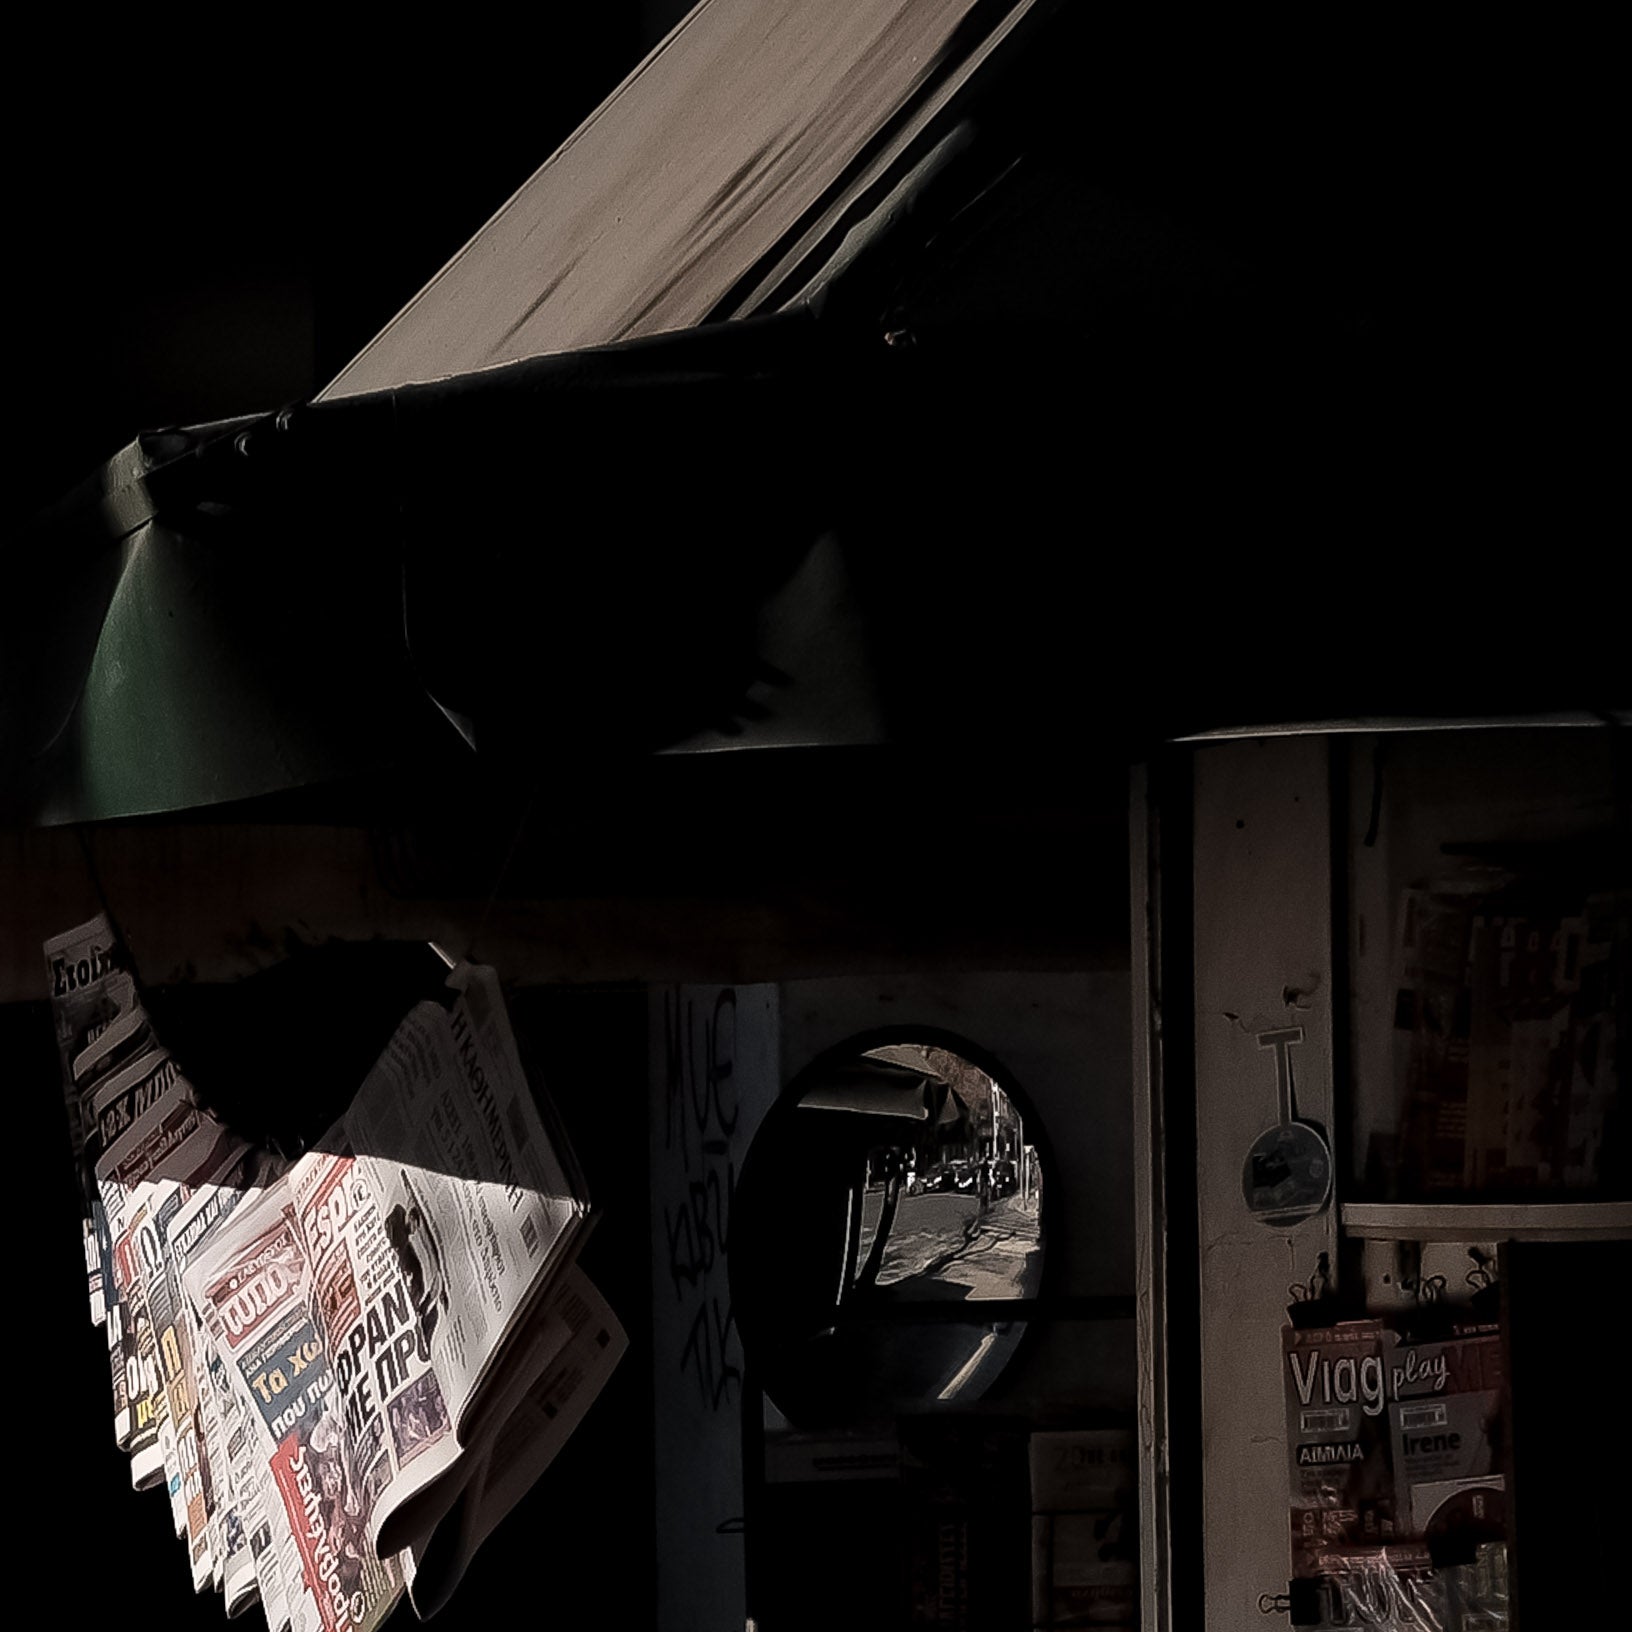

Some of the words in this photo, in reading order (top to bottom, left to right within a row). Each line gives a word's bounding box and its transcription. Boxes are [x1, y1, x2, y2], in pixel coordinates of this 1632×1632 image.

[456, 1035, 524, 1213] ΚΑΘΗΜΕΡΙΝΗ
[1391, 1350, 1451, 1402] play
[1402, 1432, 1462, 1456] Irene
